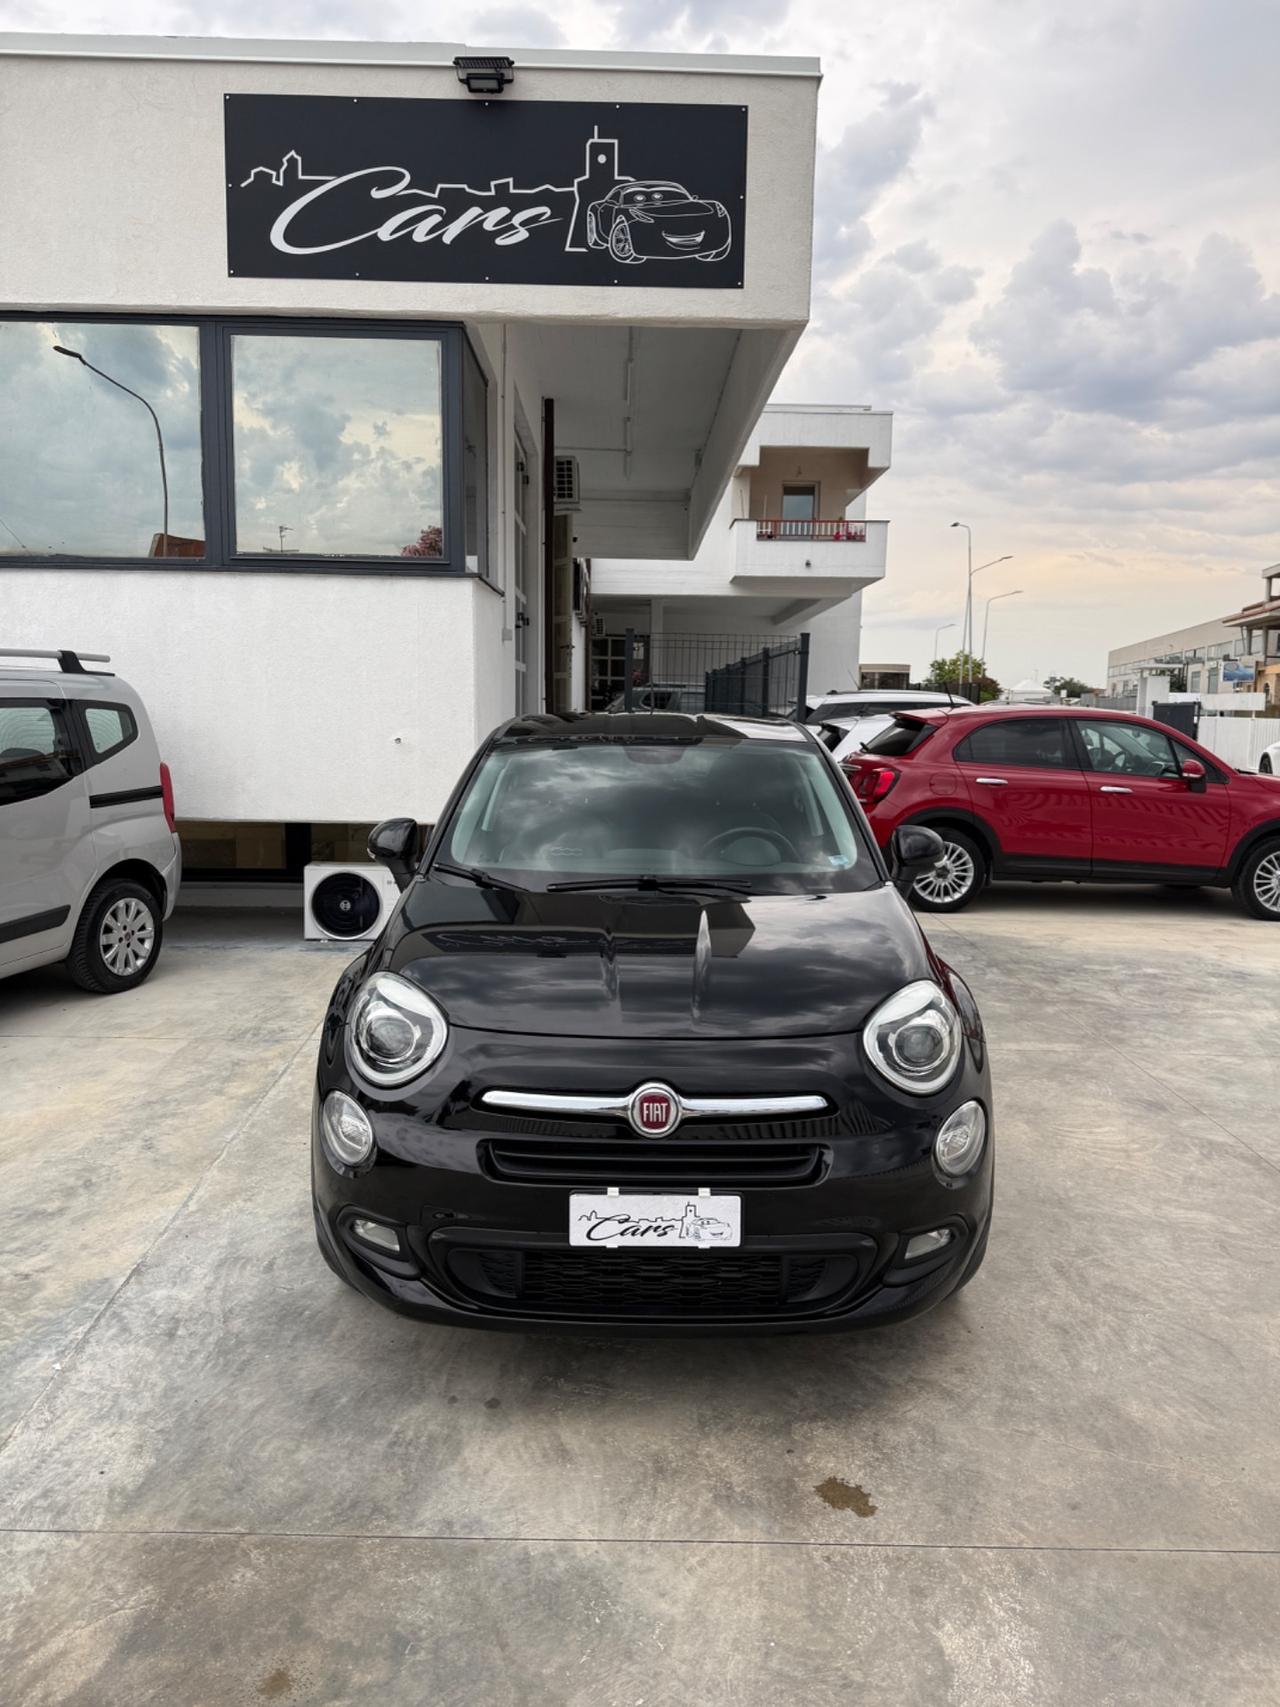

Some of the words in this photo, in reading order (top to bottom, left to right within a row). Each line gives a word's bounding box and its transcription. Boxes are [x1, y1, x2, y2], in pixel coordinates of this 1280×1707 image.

[270, 166, 562, 255] Cars
[643, 1102, 668, 1122] FIAT
[586, 1213, 677, 1241] Cars
